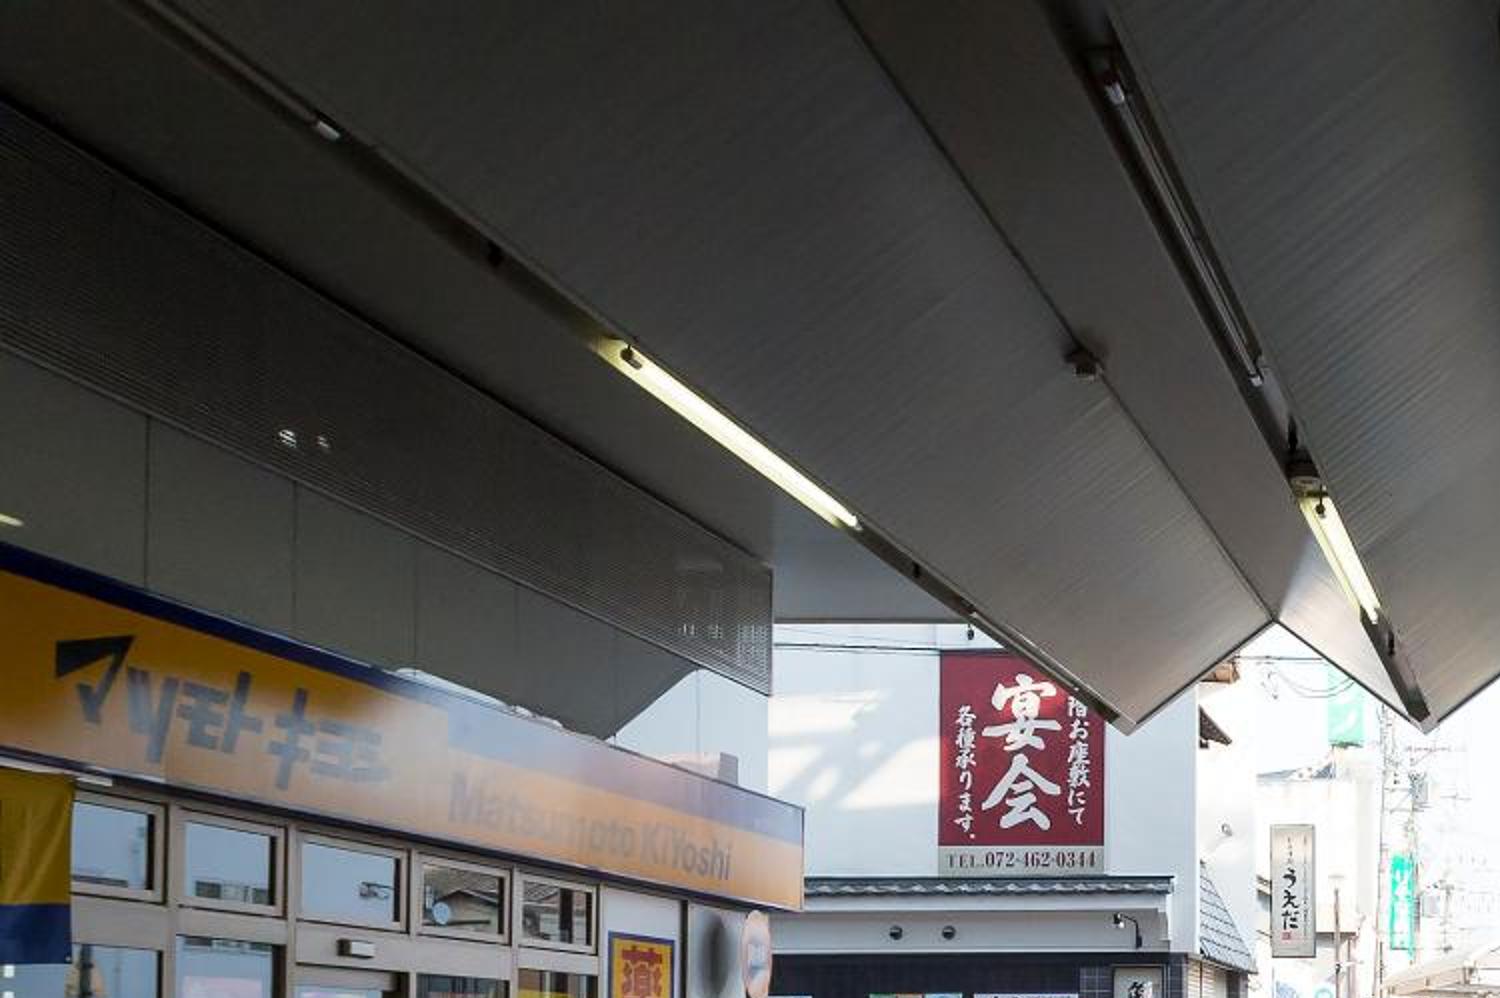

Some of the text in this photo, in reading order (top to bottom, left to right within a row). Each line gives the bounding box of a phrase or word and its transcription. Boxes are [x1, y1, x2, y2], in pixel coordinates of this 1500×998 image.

[981, 673, 1062, 830] 宴会
[1282, 867, 1299, 930] うえだ
